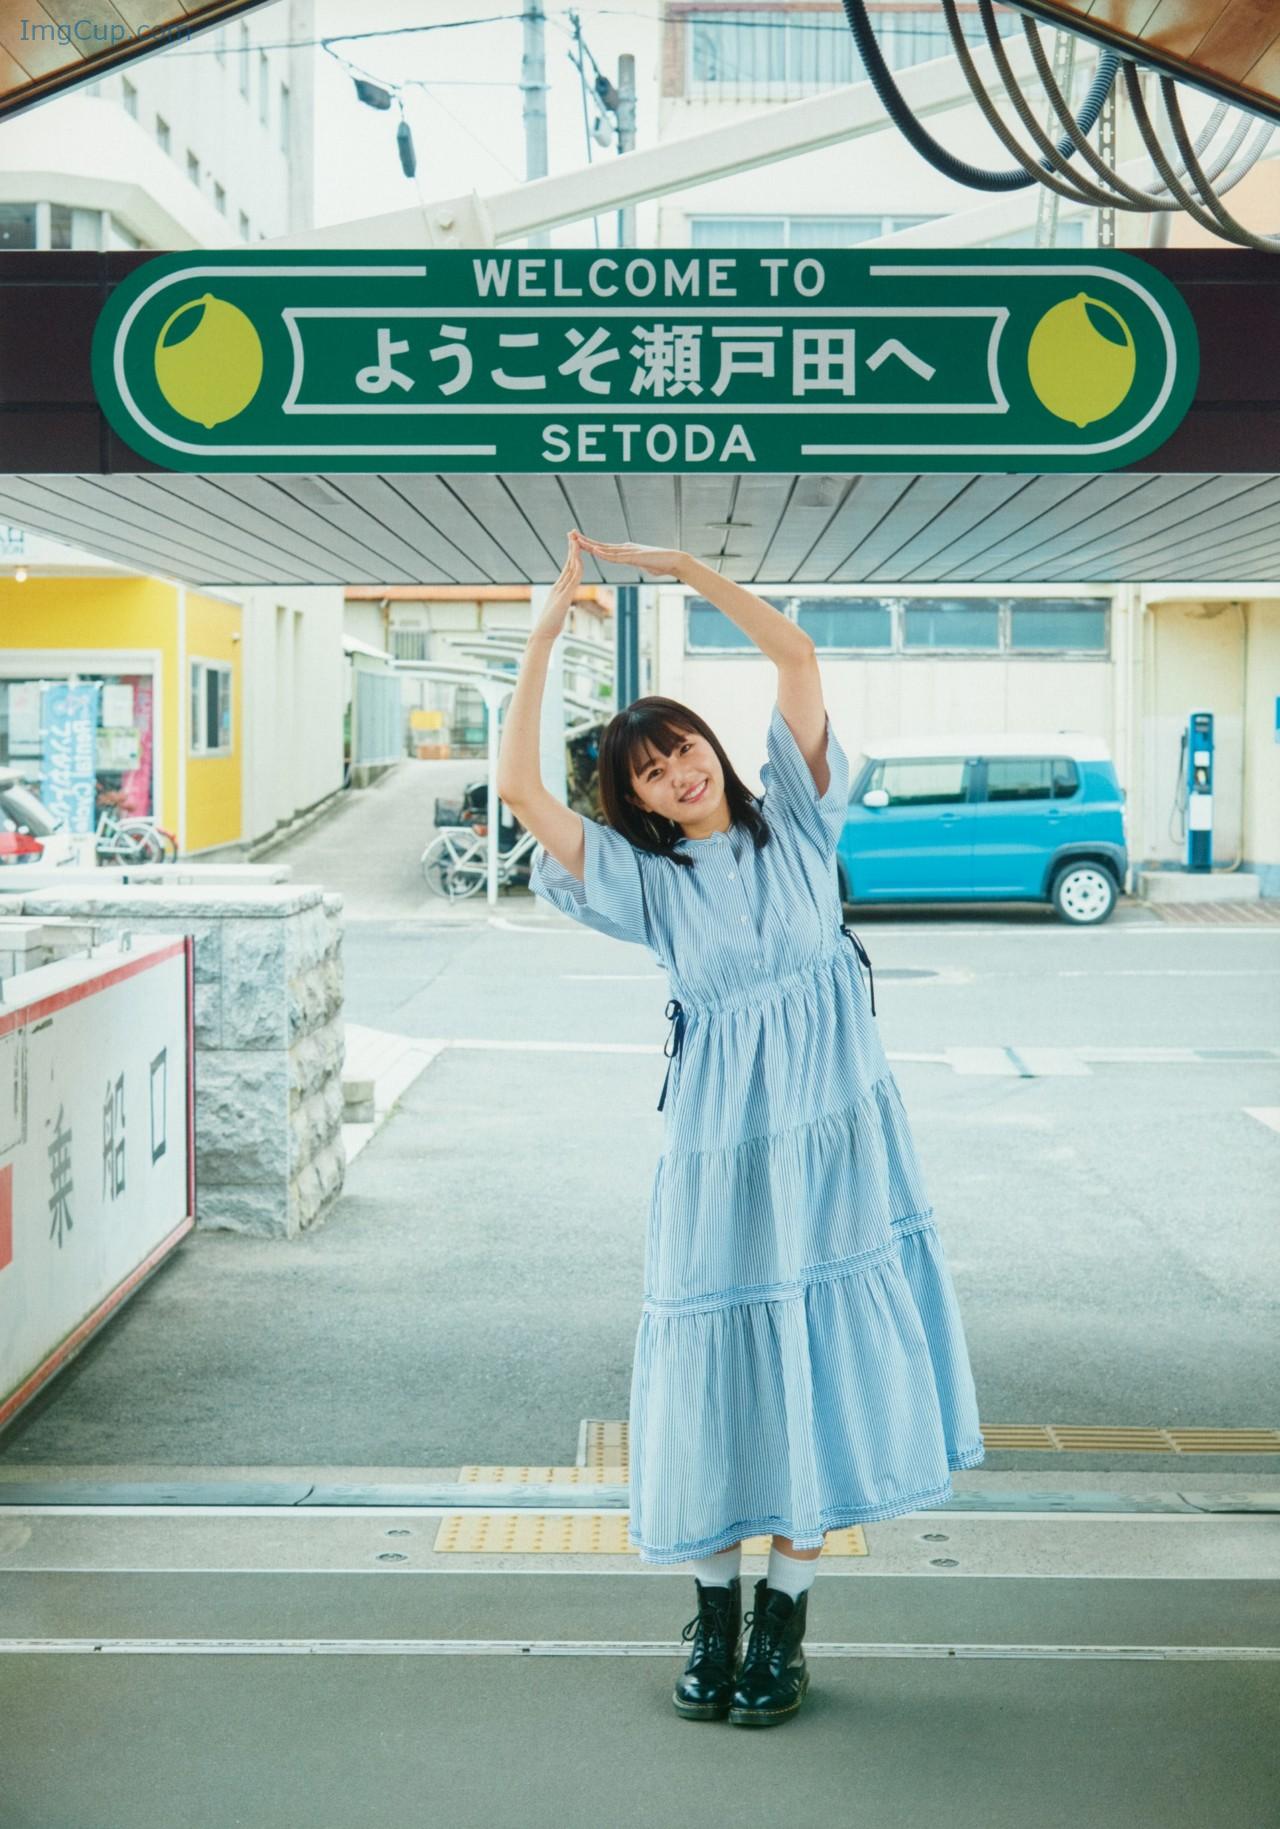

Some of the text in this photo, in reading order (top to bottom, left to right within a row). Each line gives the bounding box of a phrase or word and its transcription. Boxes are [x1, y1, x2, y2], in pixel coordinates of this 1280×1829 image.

[473, 258, 825, 297] WELCOME TO
[355, 323, 936, 397] ようこそ瀬戸田へ
[542, 423, 756, 463] SETODA
[48, 1045, 167, 1249] 乗船口
